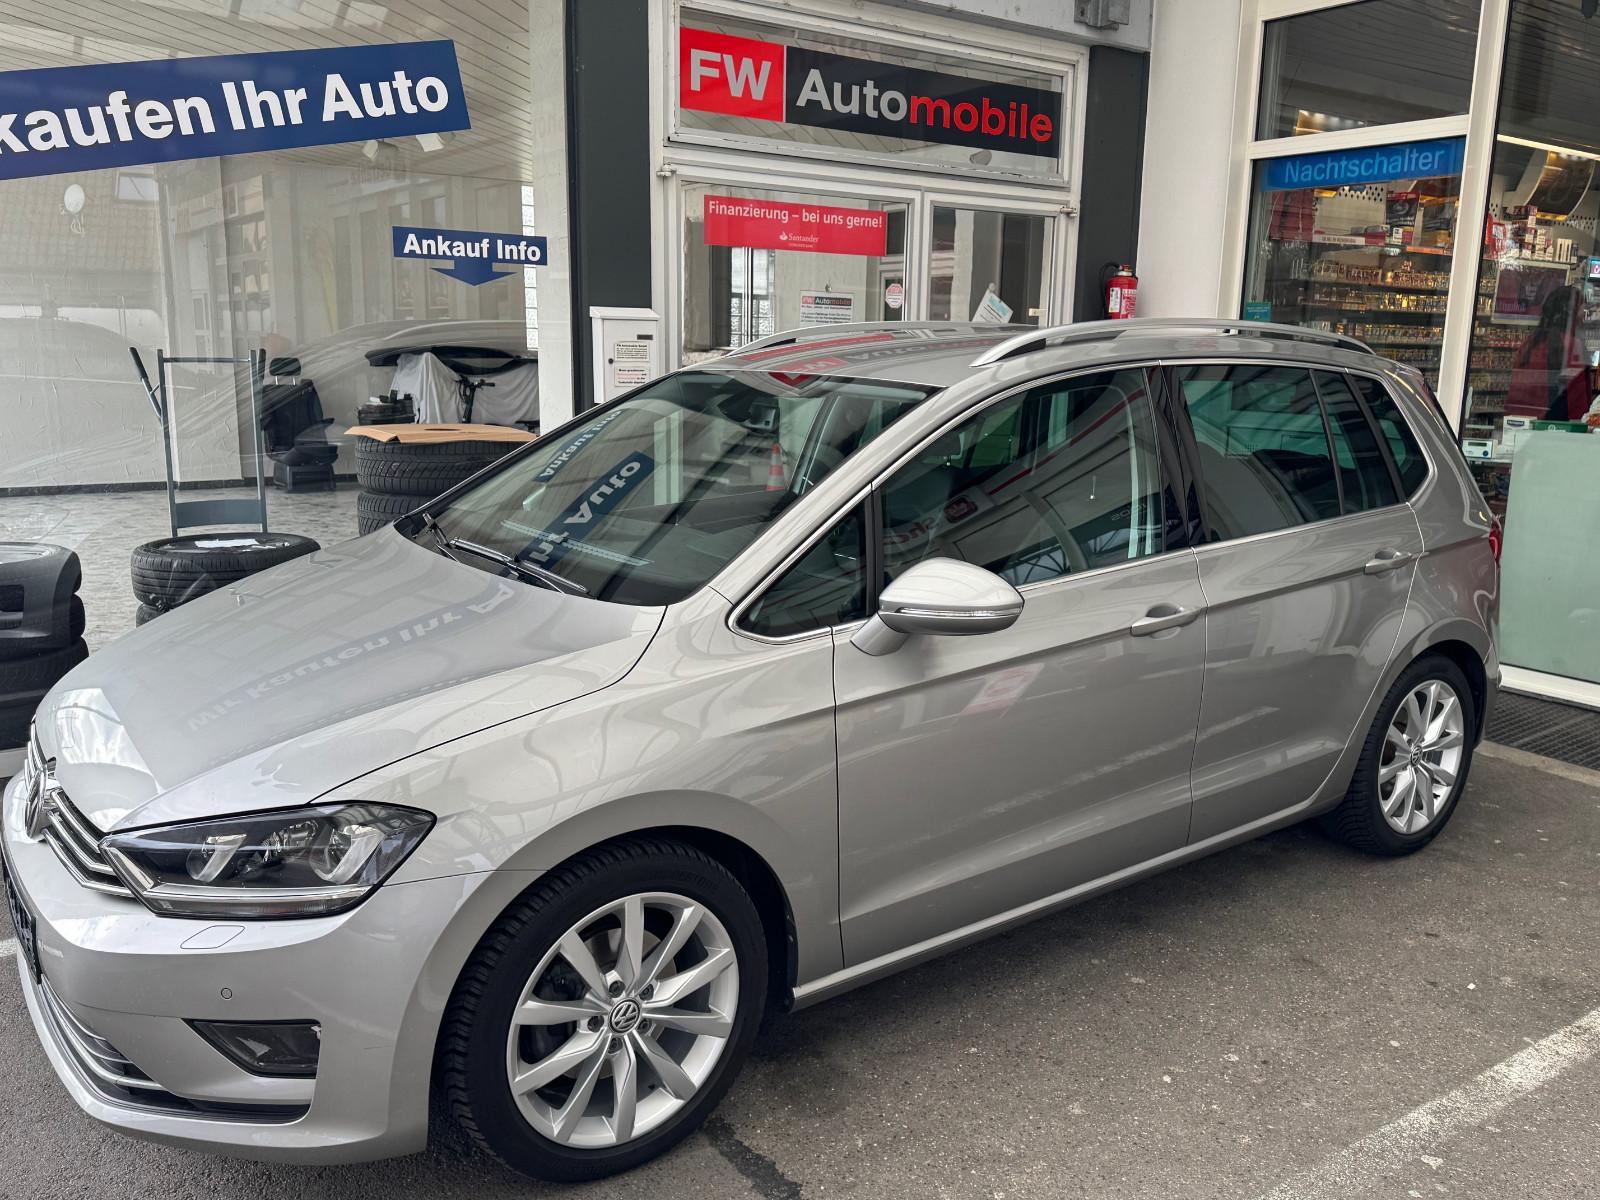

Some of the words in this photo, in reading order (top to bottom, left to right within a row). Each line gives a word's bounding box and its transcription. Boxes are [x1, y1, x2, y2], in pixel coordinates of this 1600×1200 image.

[221, 80, 308, 131] Ihr
[322, 70, 449, 122] Auto
[690, 48, 772, 100] FW
[795, 68, 1053, 143] Automobile
[1284, 148, 1446, 184] Nachtschalter
[708, 200, 789, 224] Finanzierung
[802, 208, 821, 223] bei
[823, 215, 844, 225] uns
[846, 216, 883, 229] gerne!
[403, 233, 490, 258] Ankauf
[497, 239, 541, 262] Info
[788, 231, 819, 243] Santander
